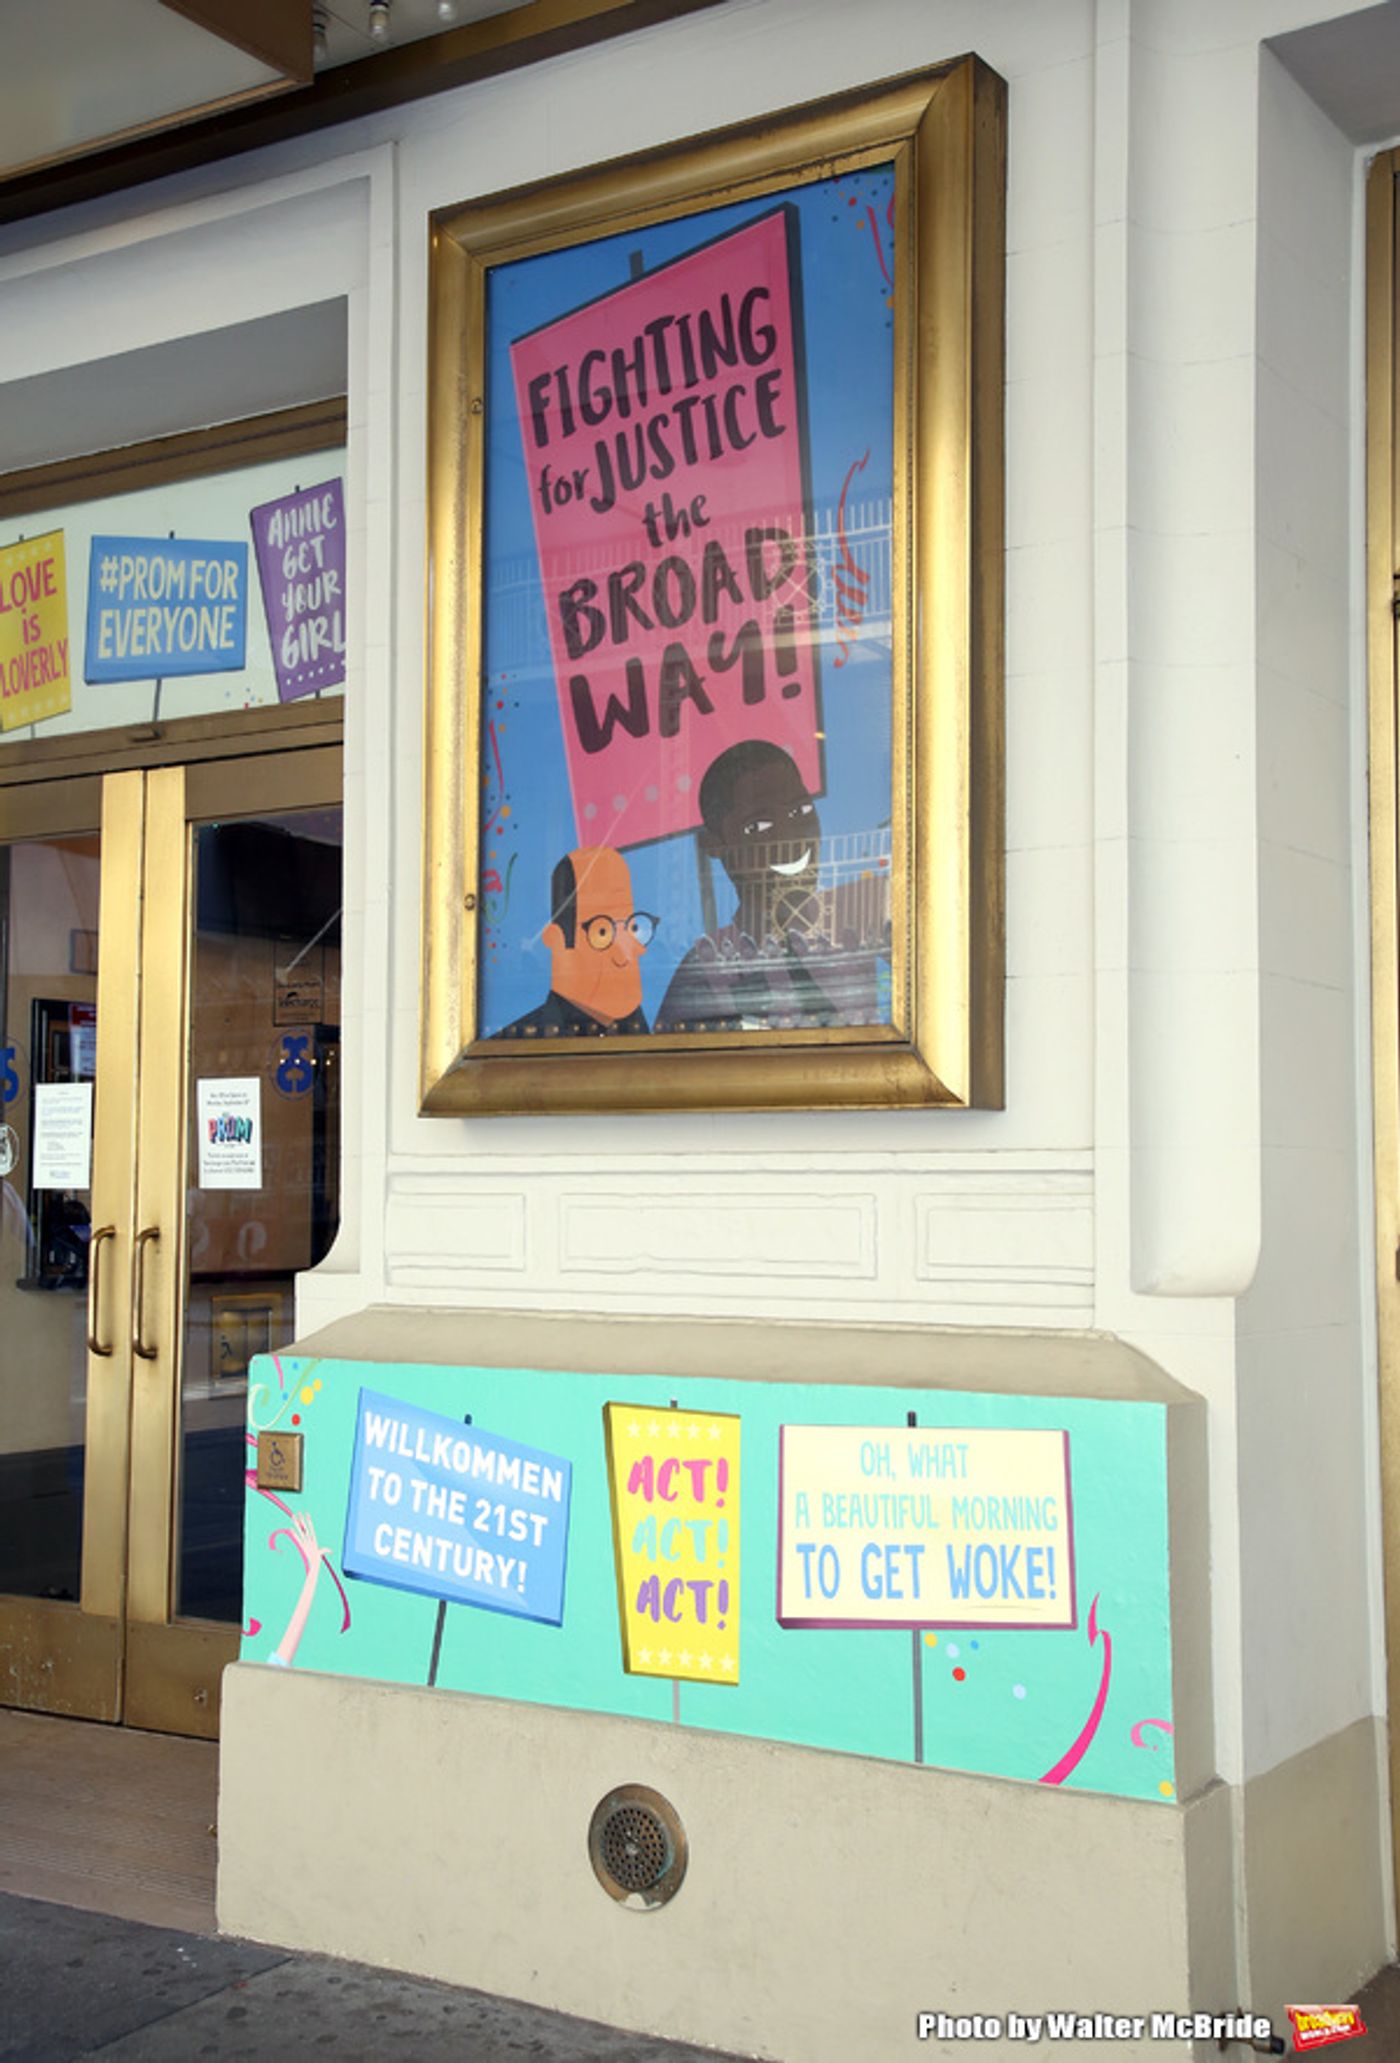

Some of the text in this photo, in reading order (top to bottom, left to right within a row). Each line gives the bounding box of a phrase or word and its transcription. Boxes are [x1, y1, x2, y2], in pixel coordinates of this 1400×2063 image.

[527, 287, 777, 449] FIGHTING
[538, 369, 786, 514] for JUSTICE
[268, 493, 337, 549] ANNIE
[642, 492, 711, 548] the
[0, 557, 57, 614] LOVE
[100, 555, 239, 600] #PROM FOR
[282, 535, 325, 580] GET
[281, 569, 341, 622] YOUR
[558, 527, 798, 661] BROAD
[22, 607, 41, 645] is
[98, 605, 236, 659] EVERYONE
[281, 610, 345, 669] GIRL
[0, 638, 68, 699] LOVERLY
[570, 604, 802, 754] WAY!
[364, 1410, 563, 1502] WILLKOMMEN
[627, 1455, 729, 1508] ACT!
[860, 1441, 970, 1481] OH, WHAT
[368, 1467, 549, 1547] TO THE 21ST
[795, 1492, 1058, 1531] A BEAUTIFUL MORNING
[374, 1523, 528, 1594] CENTURY!
[632, 1515, 729, 1568] ACT!
[796, 1542, 1056, 1600] TO GET WOKE!
[636, 1574, 729, 1630] ACT!
